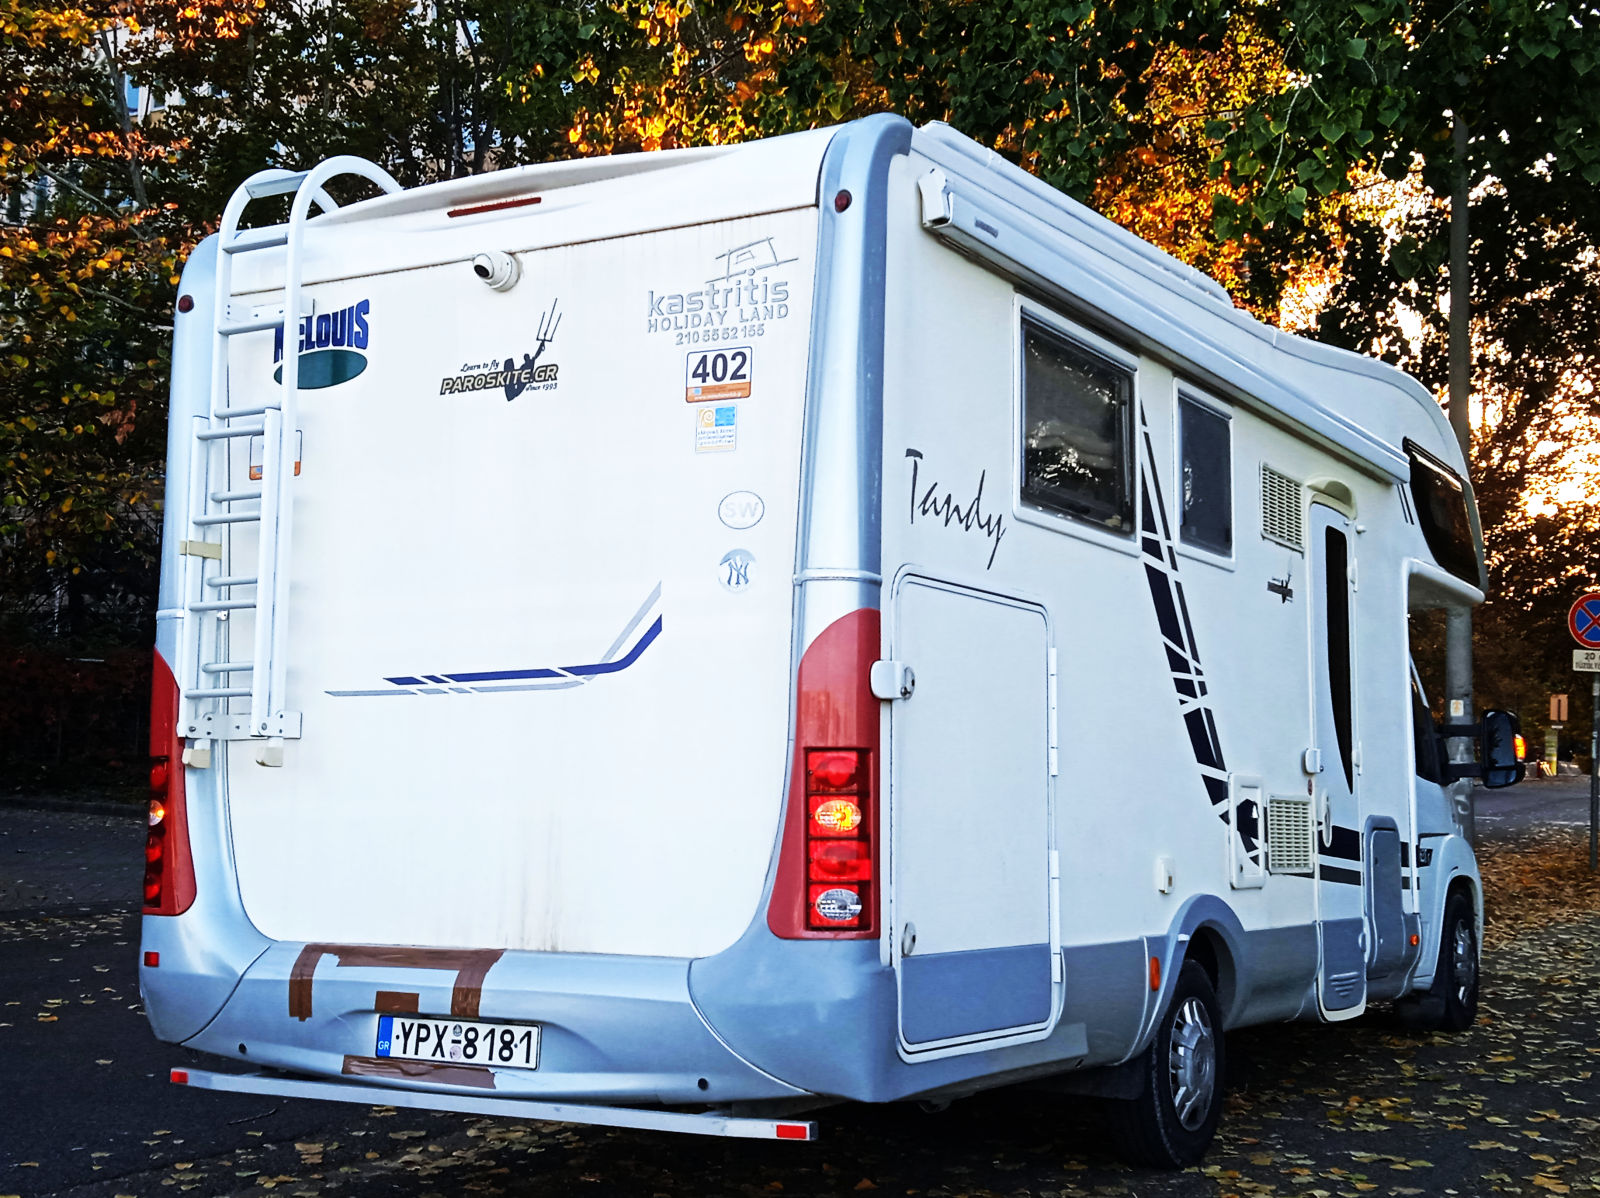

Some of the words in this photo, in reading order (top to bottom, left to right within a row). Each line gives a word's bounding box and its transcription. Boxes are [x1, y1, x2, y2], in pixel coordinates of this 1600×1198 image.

[648, 275, 789, 317] kastritis
[648, 310, 727, 333] HOLIDAY
[739, 304, 789, 323] LAND
[440, 364, 559, 395] PAROSKITE.GR
[692, 351, 747, 383] 402
[905, 448, 1007, 570] Tandy
[378, 1040, 390, 1050] GR
